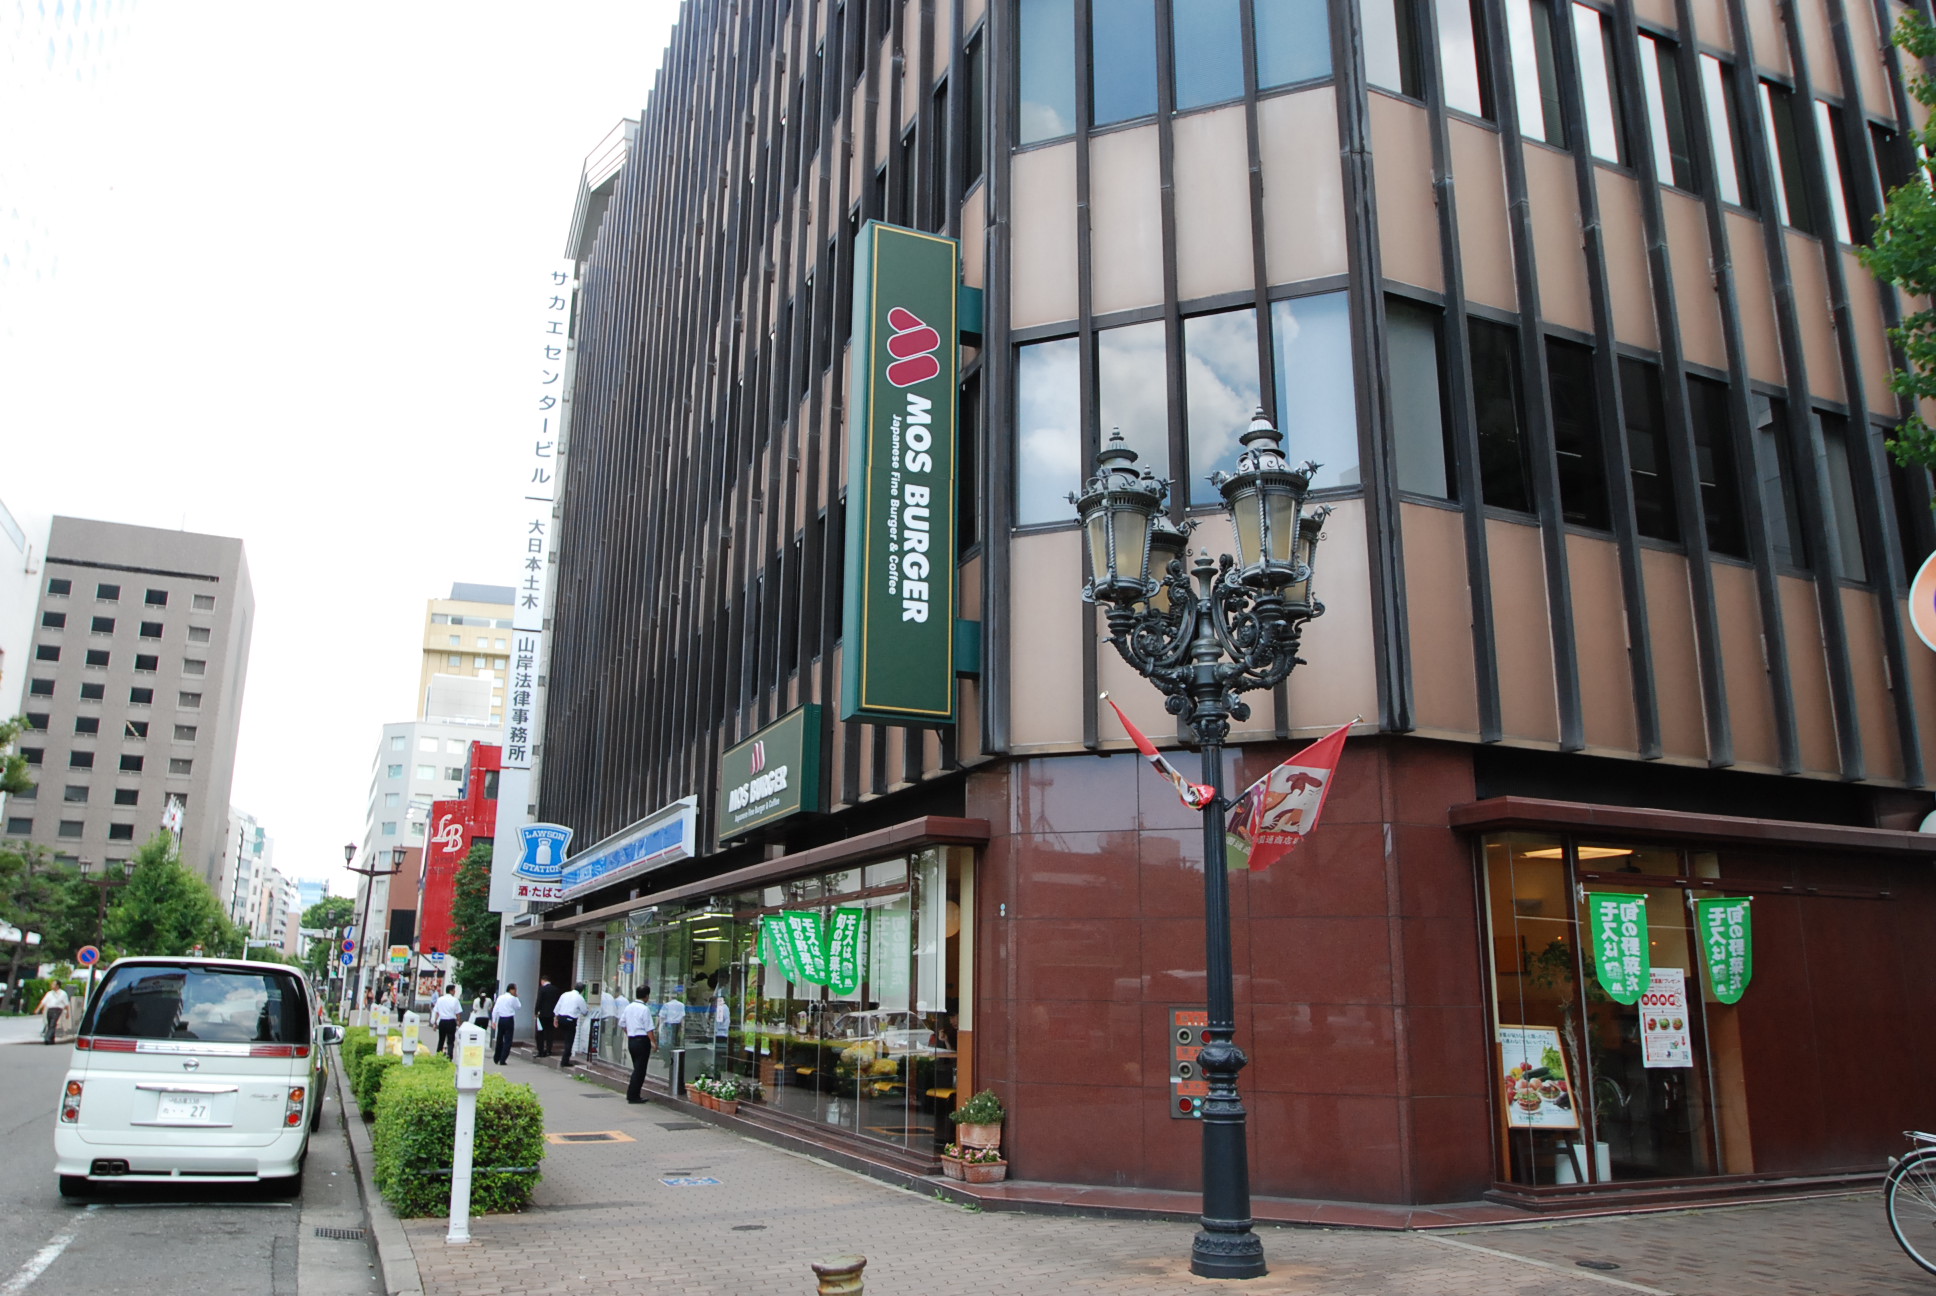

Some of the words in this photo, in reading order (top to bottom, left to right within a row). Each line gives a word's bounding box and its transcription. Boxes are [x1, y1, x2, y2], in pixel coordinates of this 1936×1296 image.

[531, 271, 569, 483] サカエセンタービル
[890, 414, 902, 469] Japanese
[904, 392, 932, 474] MOS
[890, 471, 900, 496] Fine
[887, 499, 900, 541] Burger
[521, 519, 545, 610] 大日本土木
[889, 542, 899, 552] &
[902, 483, 930, 623] BURGER
[888, 554, 899, 595] Coffee
[508, 637, 535, 762] 山岸法律事務所
[728, 783, 749, 813] MOS
[750, 765, 788, 804] BURGER
[525, 830, 566, 841] LAWSON
[190, 1105, 206, 1118] 27
